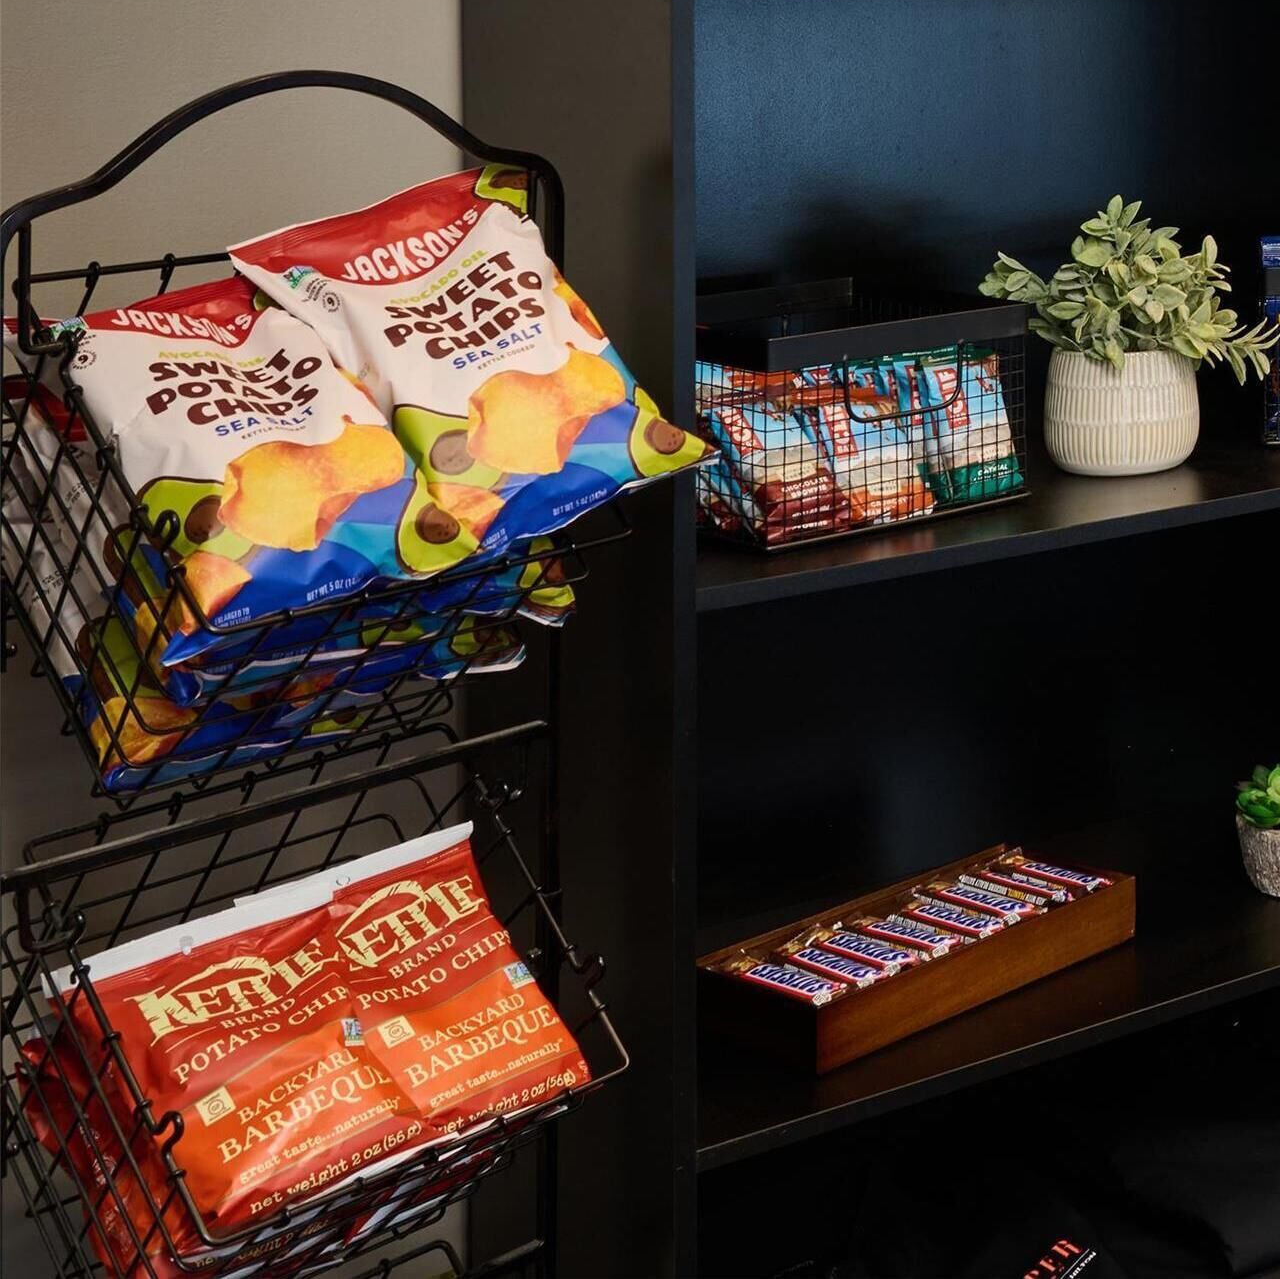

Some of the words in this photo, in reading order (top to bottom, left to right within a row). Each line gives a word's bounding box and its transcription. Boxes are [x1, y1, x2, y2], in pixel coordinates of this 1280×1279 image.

[340, 207, 479, 282] JACKSON'S
[384, 251, 516, 319] SWEET
[389, 269, 459, 305] AVOCADO
[461, 249, 489, 269] OIL
[111, 308, 253, 347] JACKSON'S
[384, 270, 544, 348] POTATO
[425, 297, 546, 360] CHIPS
[148, 348, 294, 383] SWEET
[452, 349, 494, 370] SEA
[496, 323, 545, 350] SALT
[146, 356, 323, 416] POTATO
[187, 384, 319, 425] CHIPS
[214, 416, 261, 437] SEA
[267, 406, 315, 427] SALT
[356, 966, 448, 1011] POTATO
[451, 929, 512, 970] CHIPS
[388, 931, 459, 980] BRAND
[123, 937, 346, 1048] KETTLE
[218, 997, 297, 1030] BRAND
[174, 1021, 282, 1085] POTATO
[288, 985, 351, 1027] CHIP
[402, 1003, 559, 1089] BARBEQUE
[416, 992, 527, 1052] BACKYARD
[428, 1084, 466, 1109] great
[521, 1089, 530, 1103] 2
[530, 1082, 546, 1097] oz
[239, 1153, 281, 1186] great
[249, 1192, 284, 1215] net
[351, 1153, 362, 1167] 2
[363, 1142, 382, 1161] oz
